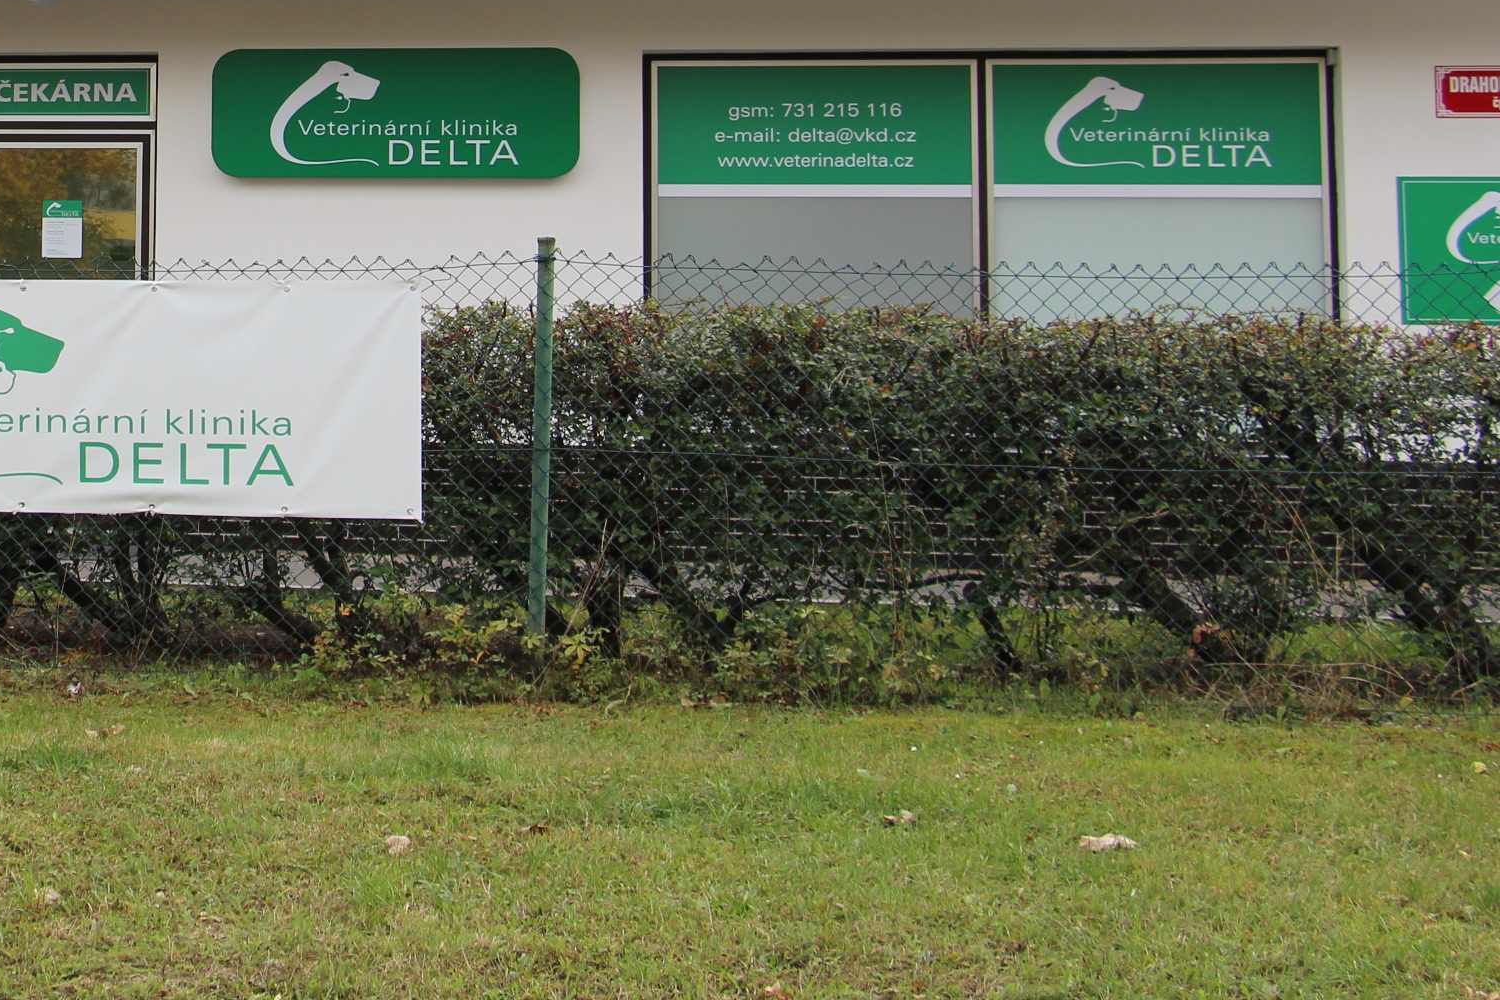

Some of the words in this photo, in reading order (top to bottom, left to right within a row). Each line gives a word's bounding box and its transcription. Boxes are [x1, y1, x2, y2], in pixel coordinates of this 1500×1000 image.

[1449, 76, 1500, 93] DRAHO
[728, 105, 774, 121] gsm:
[781, 102, 814, 118] 731
[823, 102, 860, 118] 215
[867, 102, 903, 118] 116
[297, 119, 431, 136] Veterinární
[441, 119, 518, 136] klinika
[714, 127, 781, 143] e-mail:
[788, 127, 917, 145] delta@vkd.cz
[1069, 126, 1191, 142] Veterinární
[1199, 126, 1270, 142] klinika
[388, 139, 519, 166] DELTA
[717, 152, 914, 168] www.veterinadelta.cz
[1152, 144, 1272, 168] DELTA
[165, 407, 293, 437] klinika
[78, 441, 295, 487] DELTA
